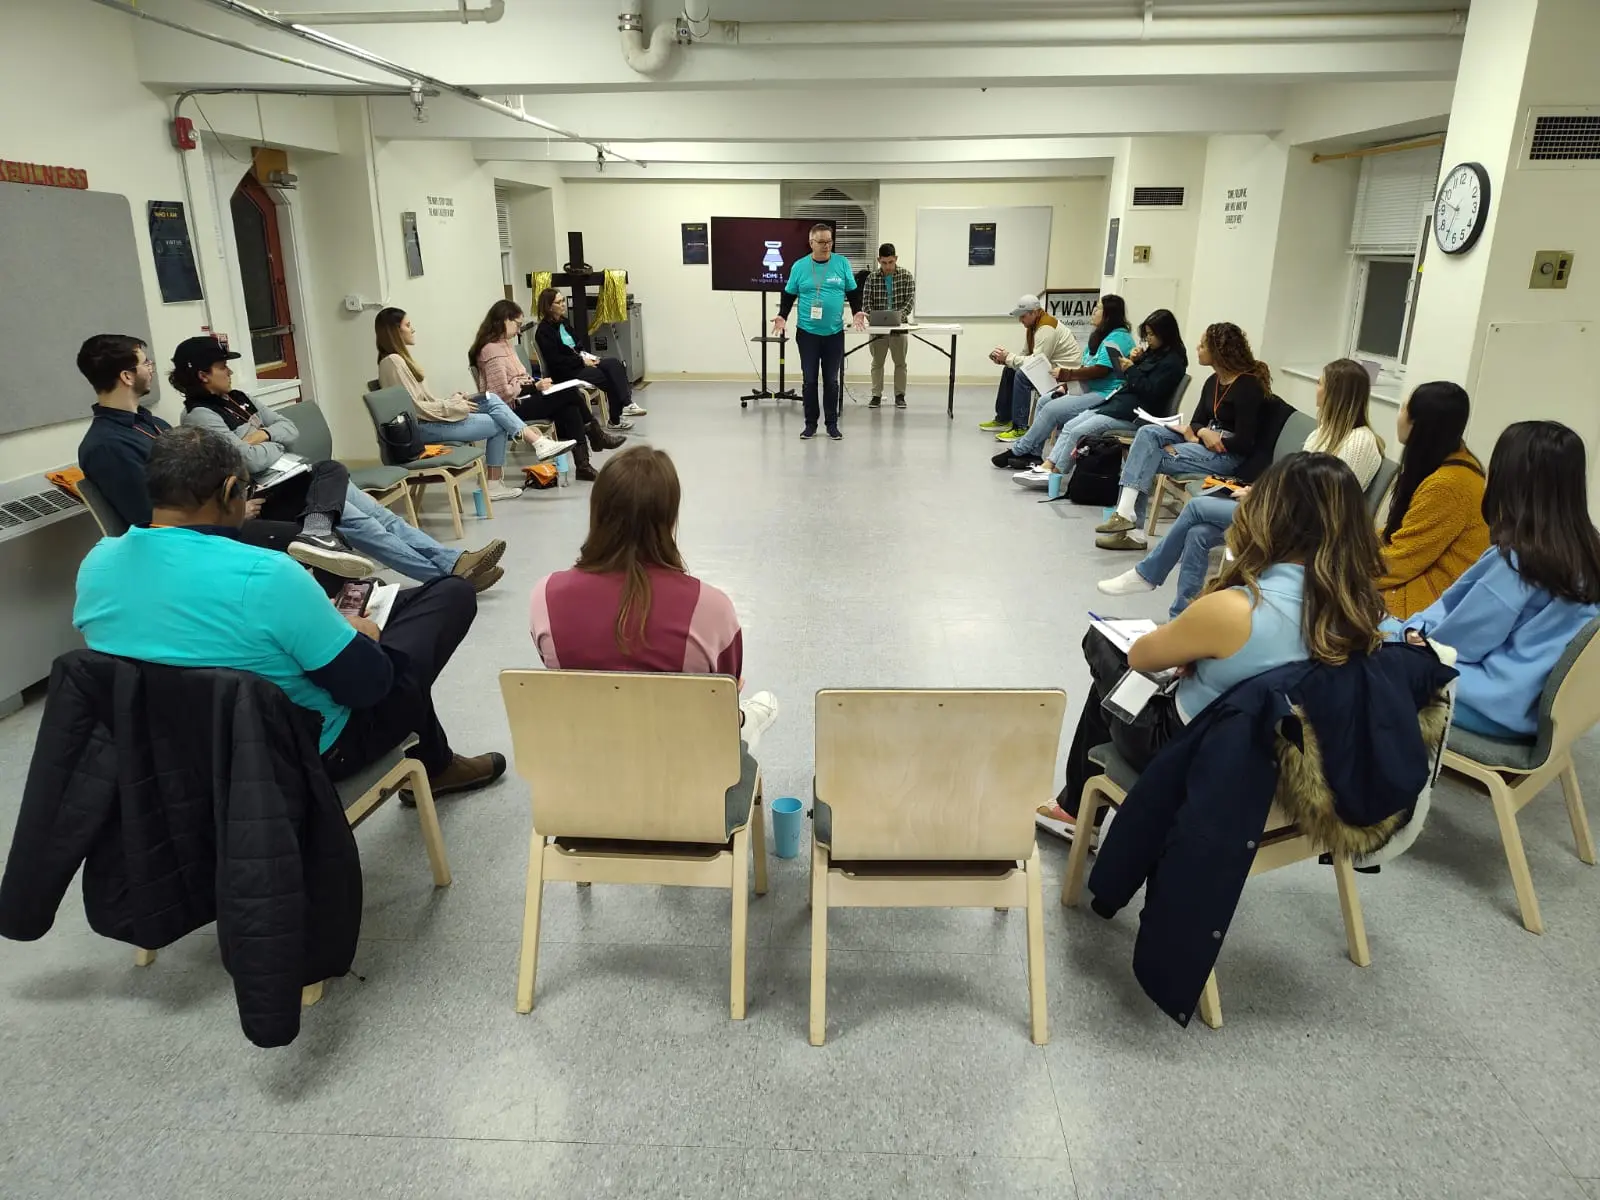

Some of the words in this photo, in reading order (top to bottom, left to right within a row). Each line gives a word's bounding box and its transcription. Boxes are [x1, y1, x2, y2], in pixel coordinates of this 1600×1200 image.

[1453, 177, 1459, 190] 11
[1459, 173, 1467, 185] 12
[1444, 188, 1452, 201] 10
[1472, 186, 1478, 199] 2
[1440, 204, 1446, 216] 9
[1472, 202, 1478, 213] 3
[1440, 219, 1446, 231] 8
[1467, 218, 1472, 228] 4
[1446, 229, 1451, 241] 7
[1452, 232, 1457, 244] 6
[1460, 229, 1466, 241] 5
[1049, 300, 1098, 316] YWAM
